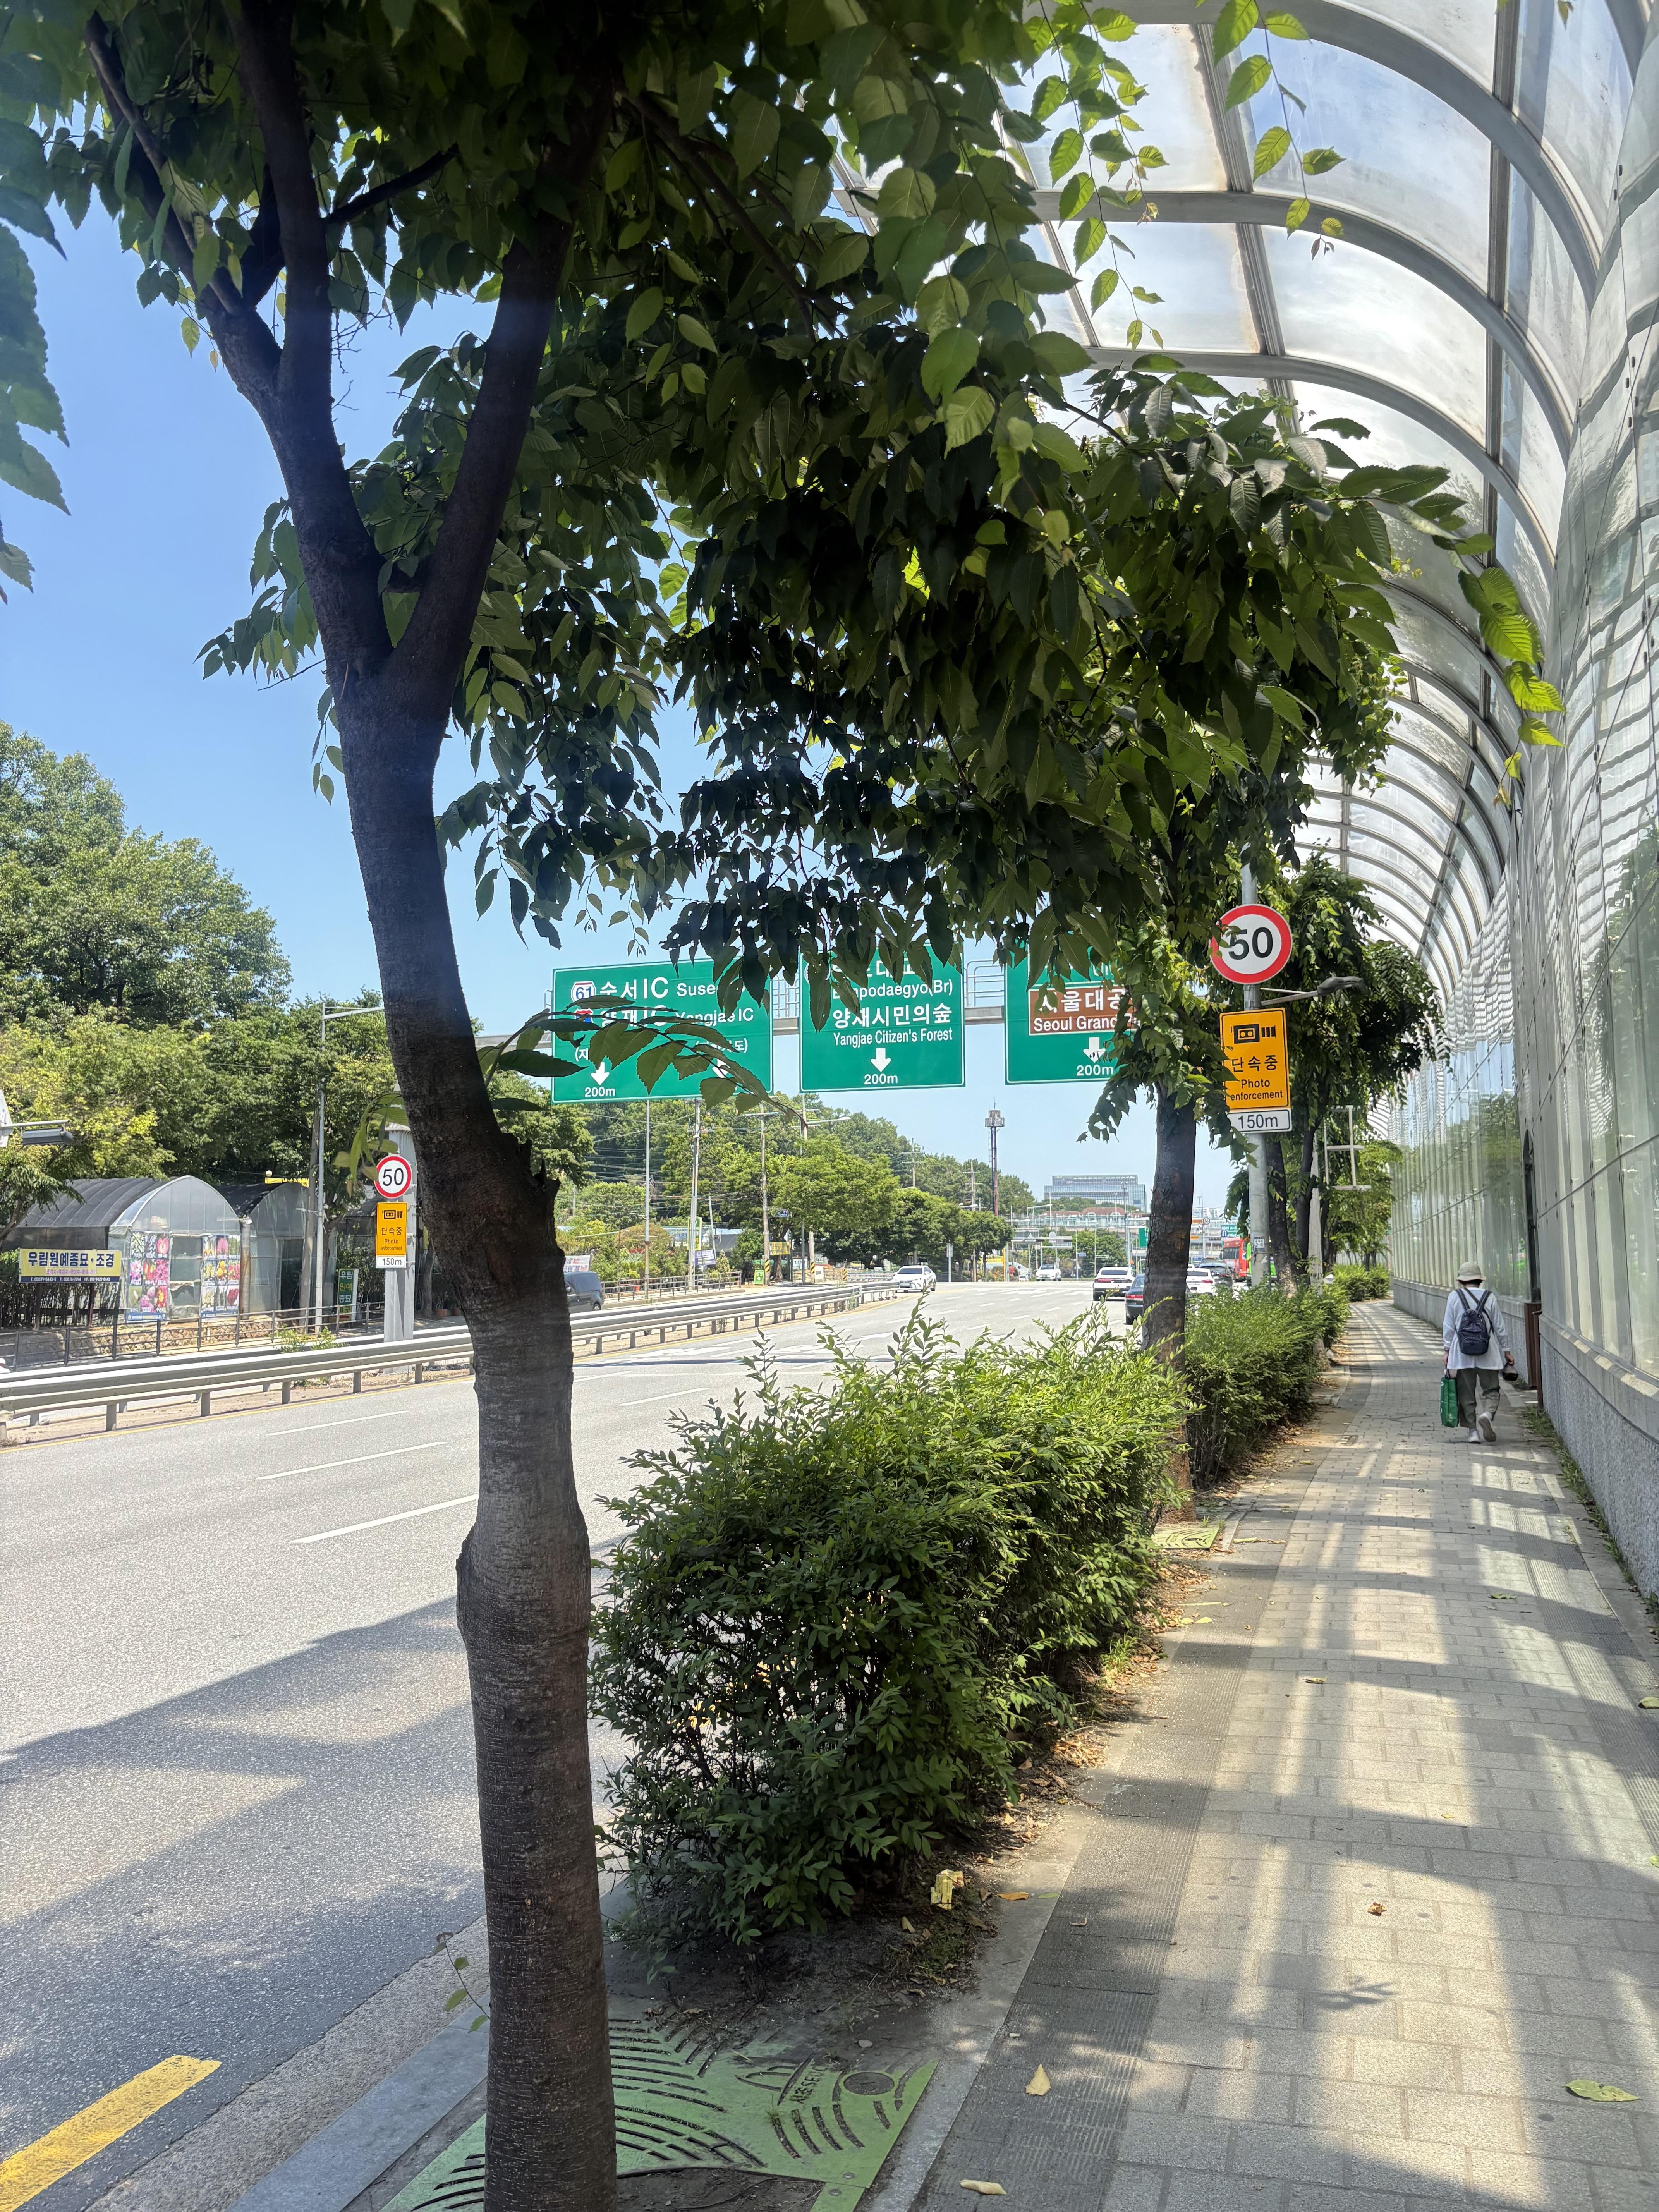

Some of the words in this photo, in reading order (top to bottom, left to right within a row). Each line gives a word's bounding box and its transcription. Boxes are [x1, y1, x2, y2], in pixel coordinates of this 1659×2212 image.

[1229, 927, 1273, 960] 50
[576, 986, 592, 1000] 61
[677, 983, 719, 997] Suse
[833, 979, 953, 1001] podaegyo(Br)
[738, 1008, 754, 1022] IC
[833, 1003, 952, 1029] 양재시민의숲
[1034, 1016, 1072, 1032] Seoul
[833, 1032, 872, 1048] Yangjae
[875, 1030, 917, 1044] Citizen's
[921, 1027, 953, 1042] Forest
[1076, 1064, 1114, 1077] 200m
[1231, 1054, 1278, 1073] 단속중
[864, 1073, 898, 1085] 200m
[1241, 1078, 1271, 1089] Photo
[584, 1086, 616, 1097] 200m
[1230, 1091, 1283, 1101] enforcement
[1238, 1114, 1279, 1130] 150m
[382, 1168, 404, 1187] 50
[381, 1226, 402, 1236] 단속중
[383, 1257, 402, 1266] 150m
[340, 1271, 353, 1279] 우림
[340, 1283, 352, 1291] 원예
[339, 1295, 351, 1303] 종묘
